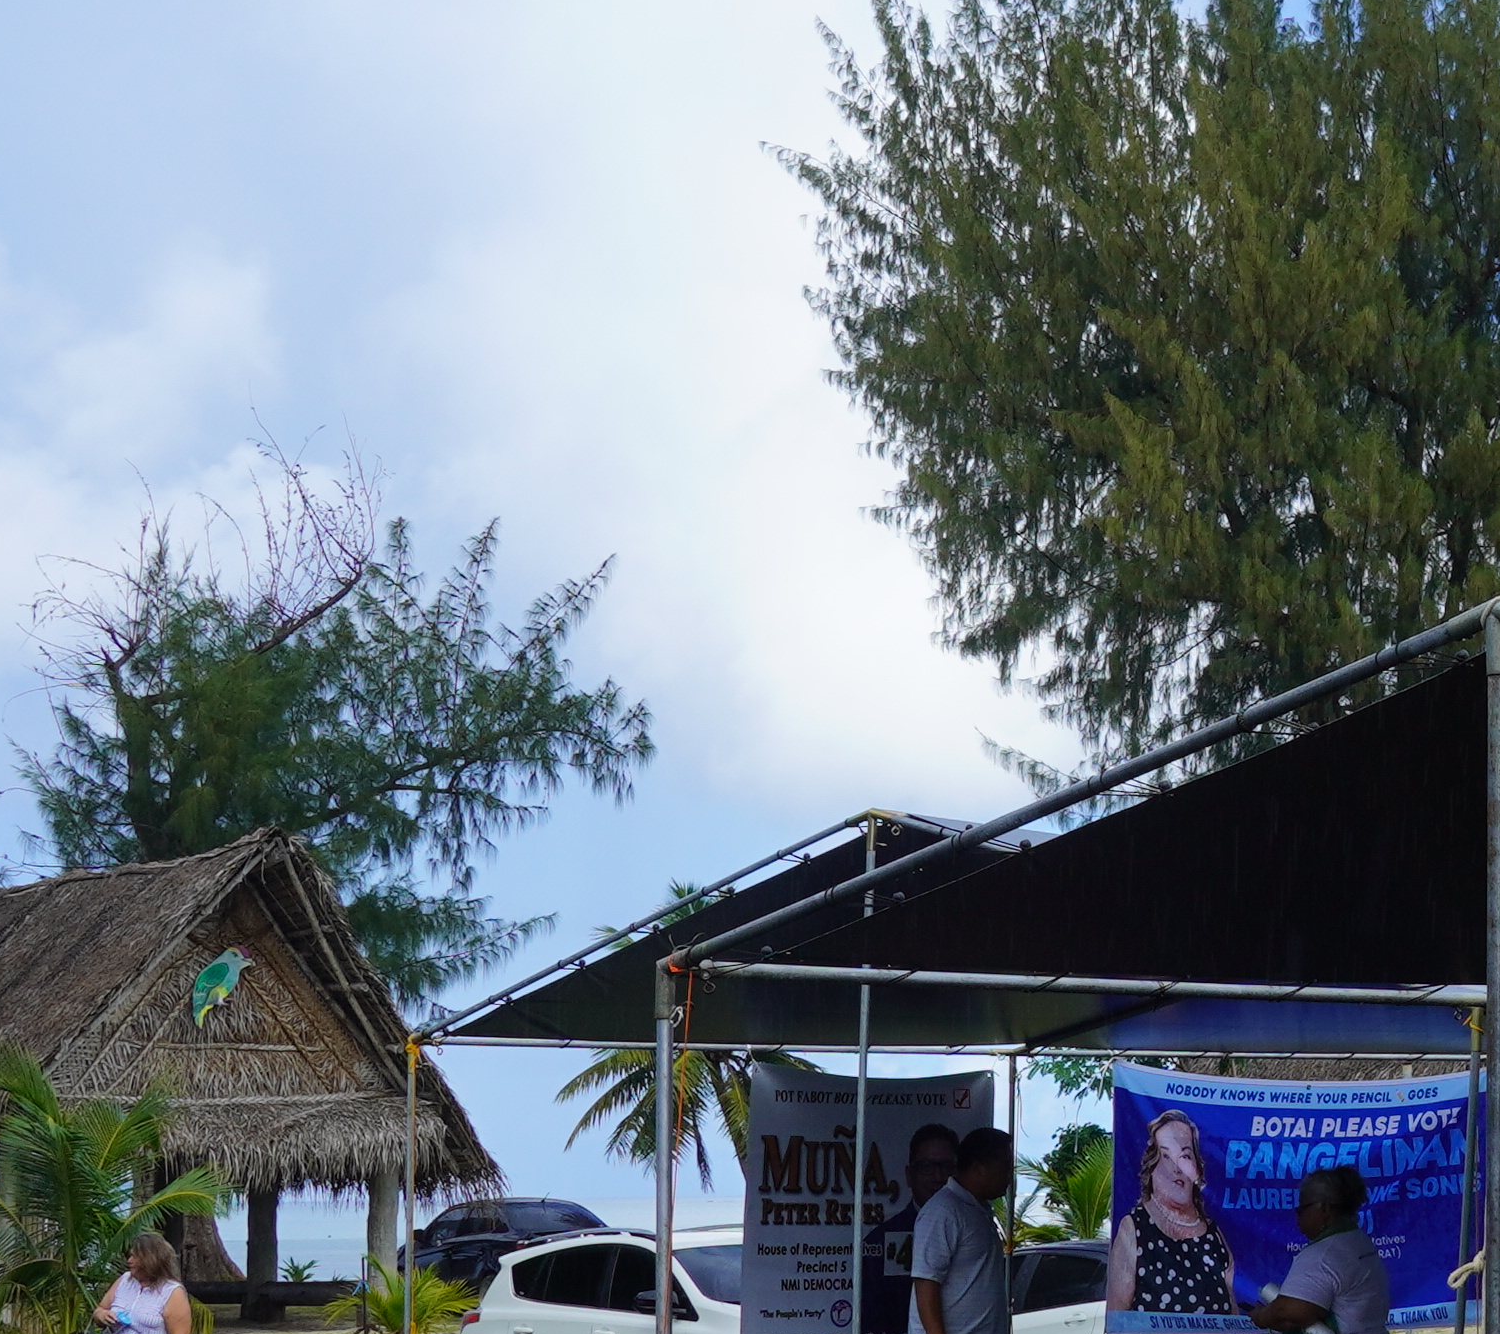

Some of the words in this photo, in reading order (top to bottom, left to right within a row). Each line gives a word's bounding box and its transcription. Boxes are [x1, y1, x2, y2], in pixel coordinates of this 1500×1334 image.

[775, 1089, 795, 1102] POT
[798, 1090, 832, 1104] FABOT
[916, 1093, 947, 1106] VOTE
[1165, 1082, 1217, 1100] NOBODY
[1220, 1088, 1266, 1104] KNOWS
[1270, 1089, 1313, 1104] WHERE
[1316, 1090, 1349, 1105] YOUR
[1351, 1089, 1393, 1104] PENCIL
[1407, 1087, 1439, 1101] GOES
[1250, 1116, 1316, 1138] BOTA!
[1320, 1114, 1401, 1138] PLEASE
[761, 1198, 821, 1225] PETER
[757, 1243, 788, 1255] House
[790, 1243, 800, 1255] of
[797, 1260, 836, 1273] Precinct
[840, 1261, 847, 1273] 5
[781, 1278, 800, 1291] NMI
[775, 1309, 803, 1320] People's
[1150, 1315, 1160, 1328] SI
[1161, 1316, 1187, 1329] YU'US
[1187, 1317, 1224, 1332] MA'ASE,
[1401, 1309, 1430, 1325] THANK
[1430, 1305, 1449, 1320] YOU
